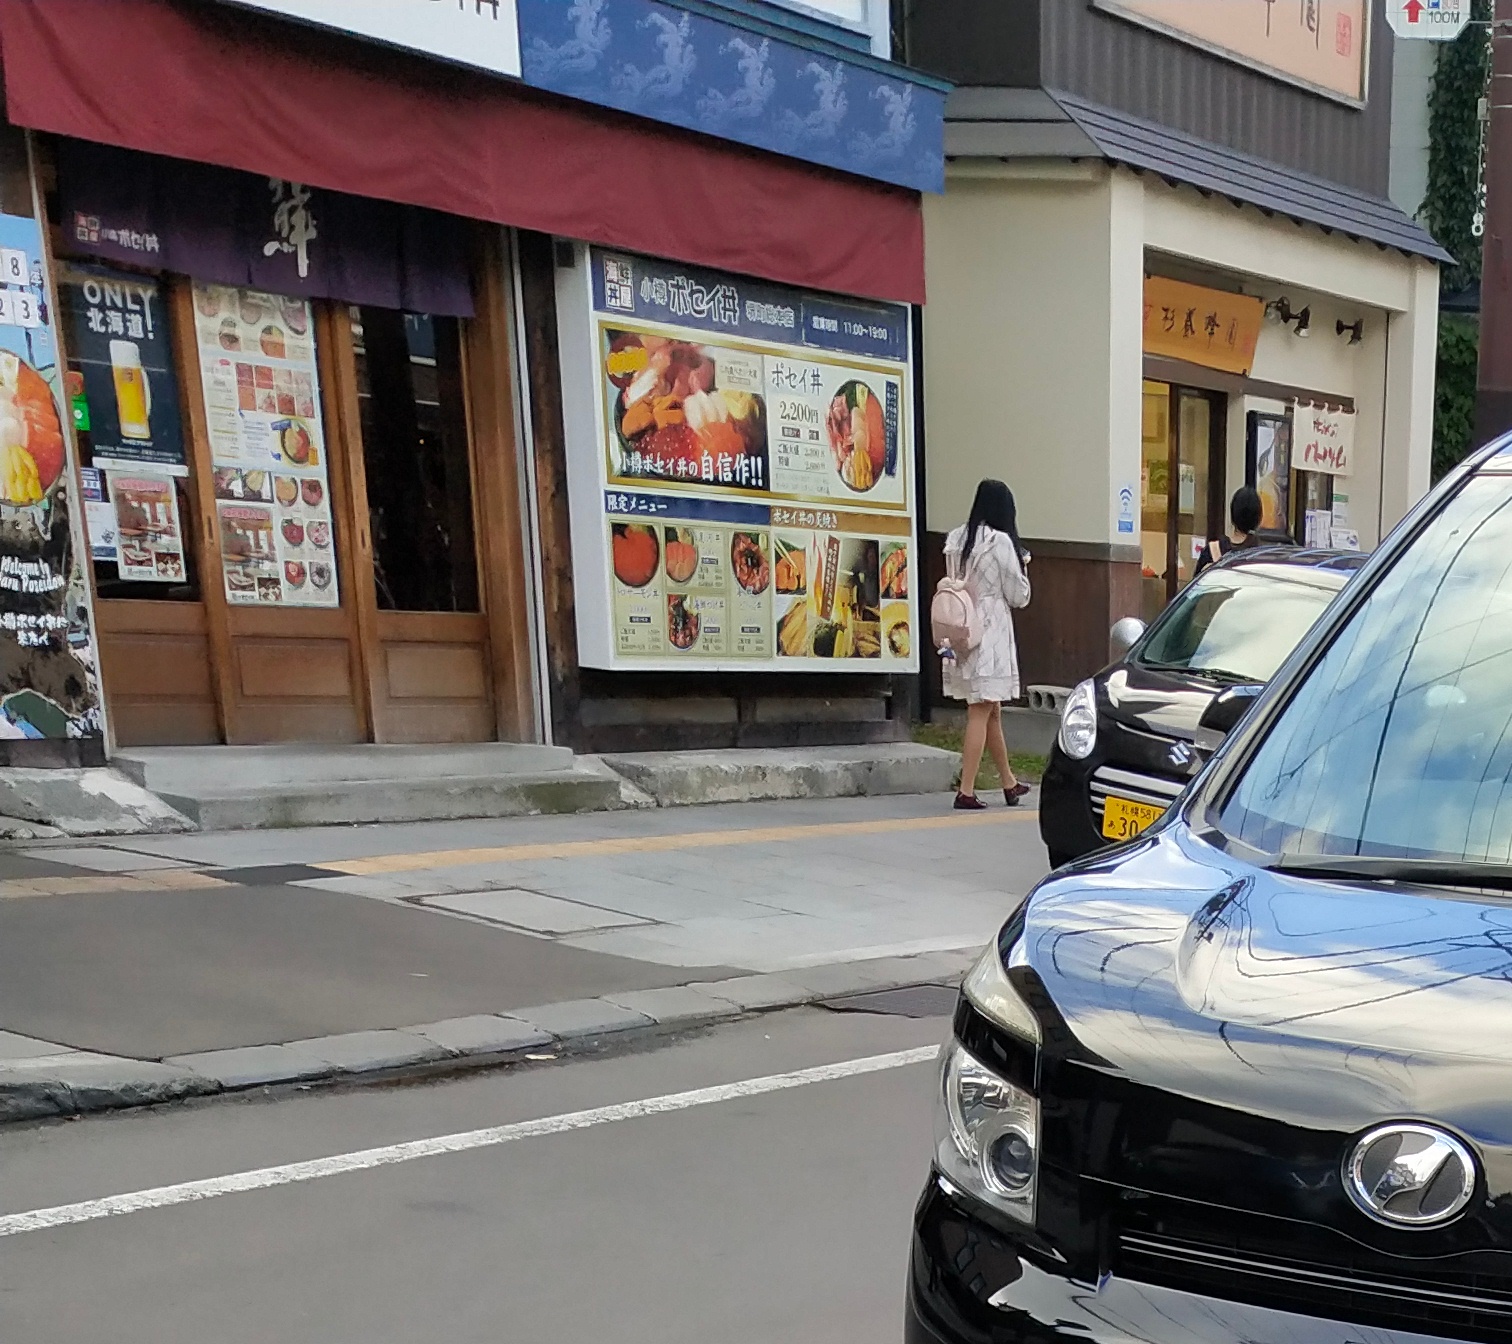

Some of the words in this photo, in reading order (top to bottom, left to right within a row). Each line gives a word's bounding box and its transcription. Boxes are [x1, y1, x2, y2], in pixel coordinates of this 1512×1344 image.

[1428, 11, 1460, 24] 100M
[11, 256, 21, 277] 8
[83, 280, 154, 318] ONLY
[771, 361, 824, 396] ポセイ丼
[606, 493, 668, 513] 限定メニュー
[21, 573, 65, 593] Poseidon
